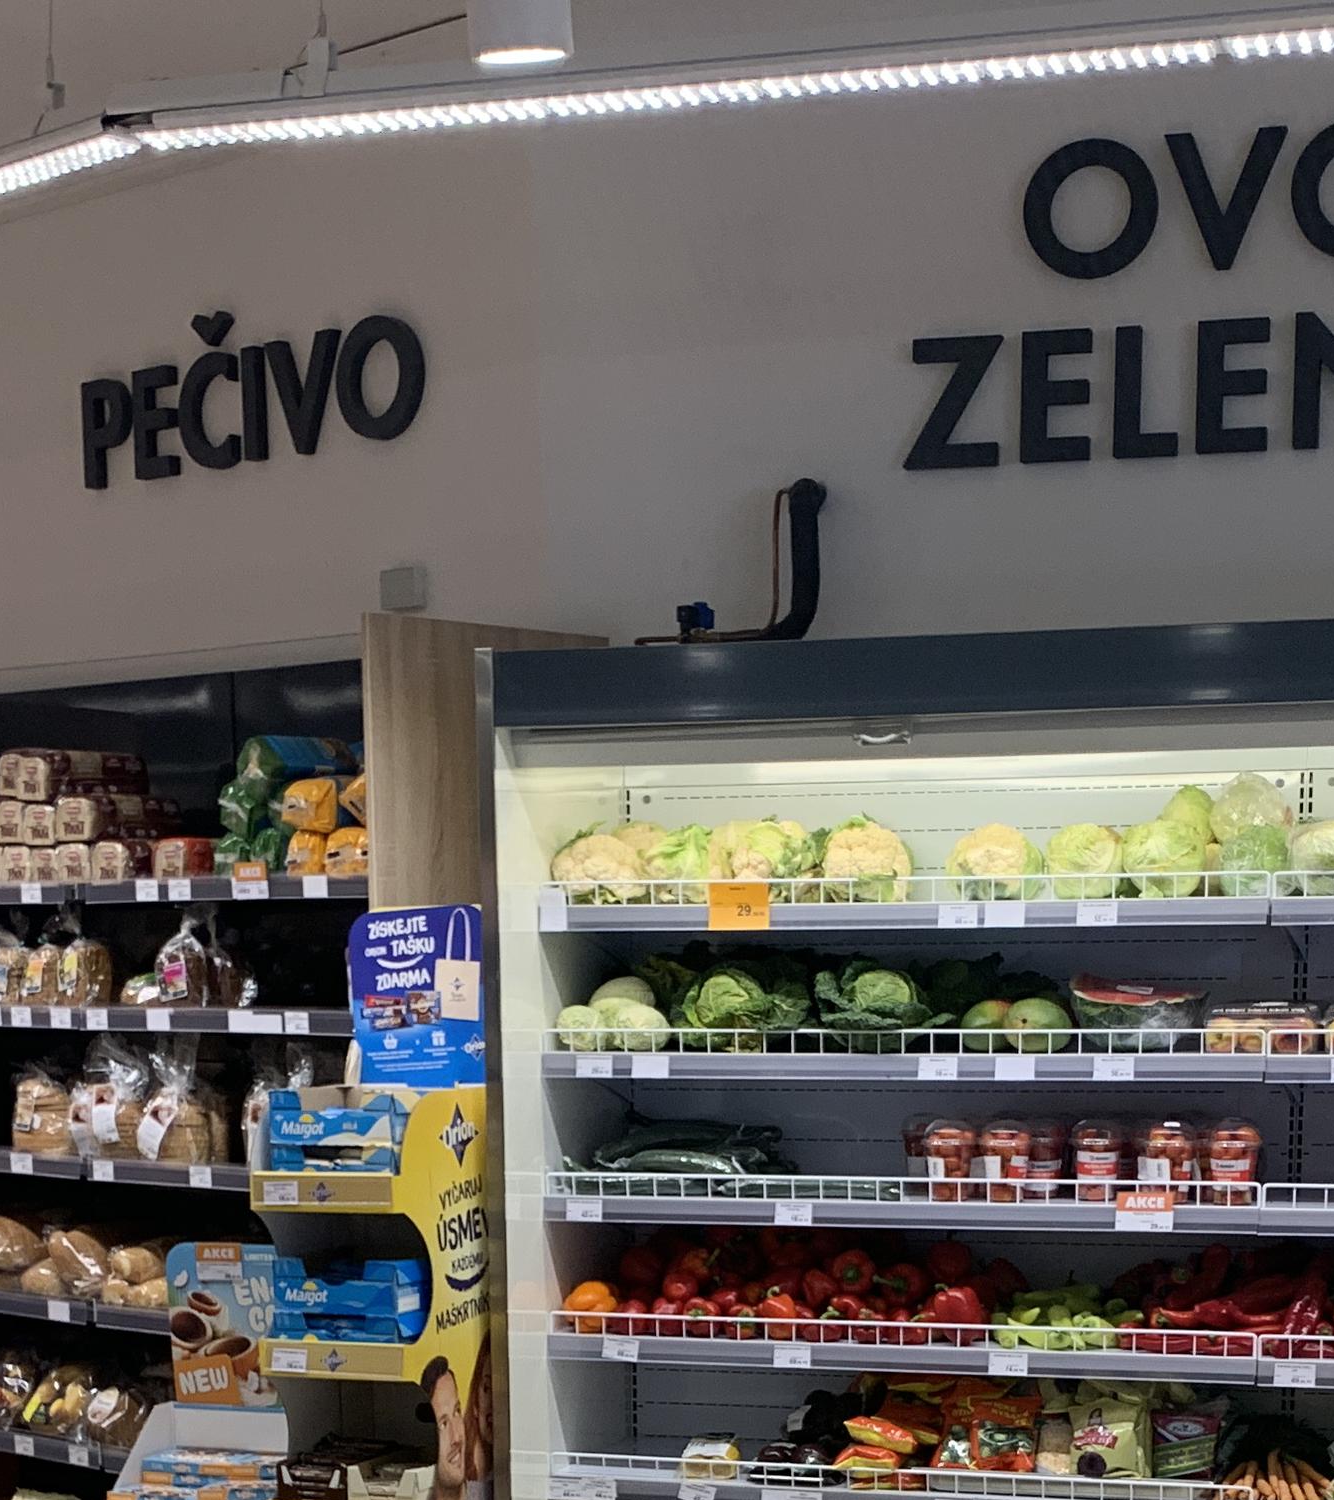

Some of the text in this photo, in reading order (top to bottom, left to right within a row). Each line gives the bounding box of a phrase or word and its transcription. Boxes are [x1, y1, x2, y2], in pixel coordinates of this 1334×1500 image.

[80, 309, 427, 491] PEČIVO
[367, 915, 428, 941] ZÍSKEJTE
[390, 936, 435, 957] TAŠKU
[375, 968, 431, 992] ZDARMA
[281, 1121, 324, 1138] Margot
[442, 1118, 475, 1147] Orion
[1124, 1196, 1165, 1209] AKCE
[202, 1248, 235, 1259] AKCE
[284, 1286, 328, 1305] Margot
[178, 1366, 229, 1395] NEW
